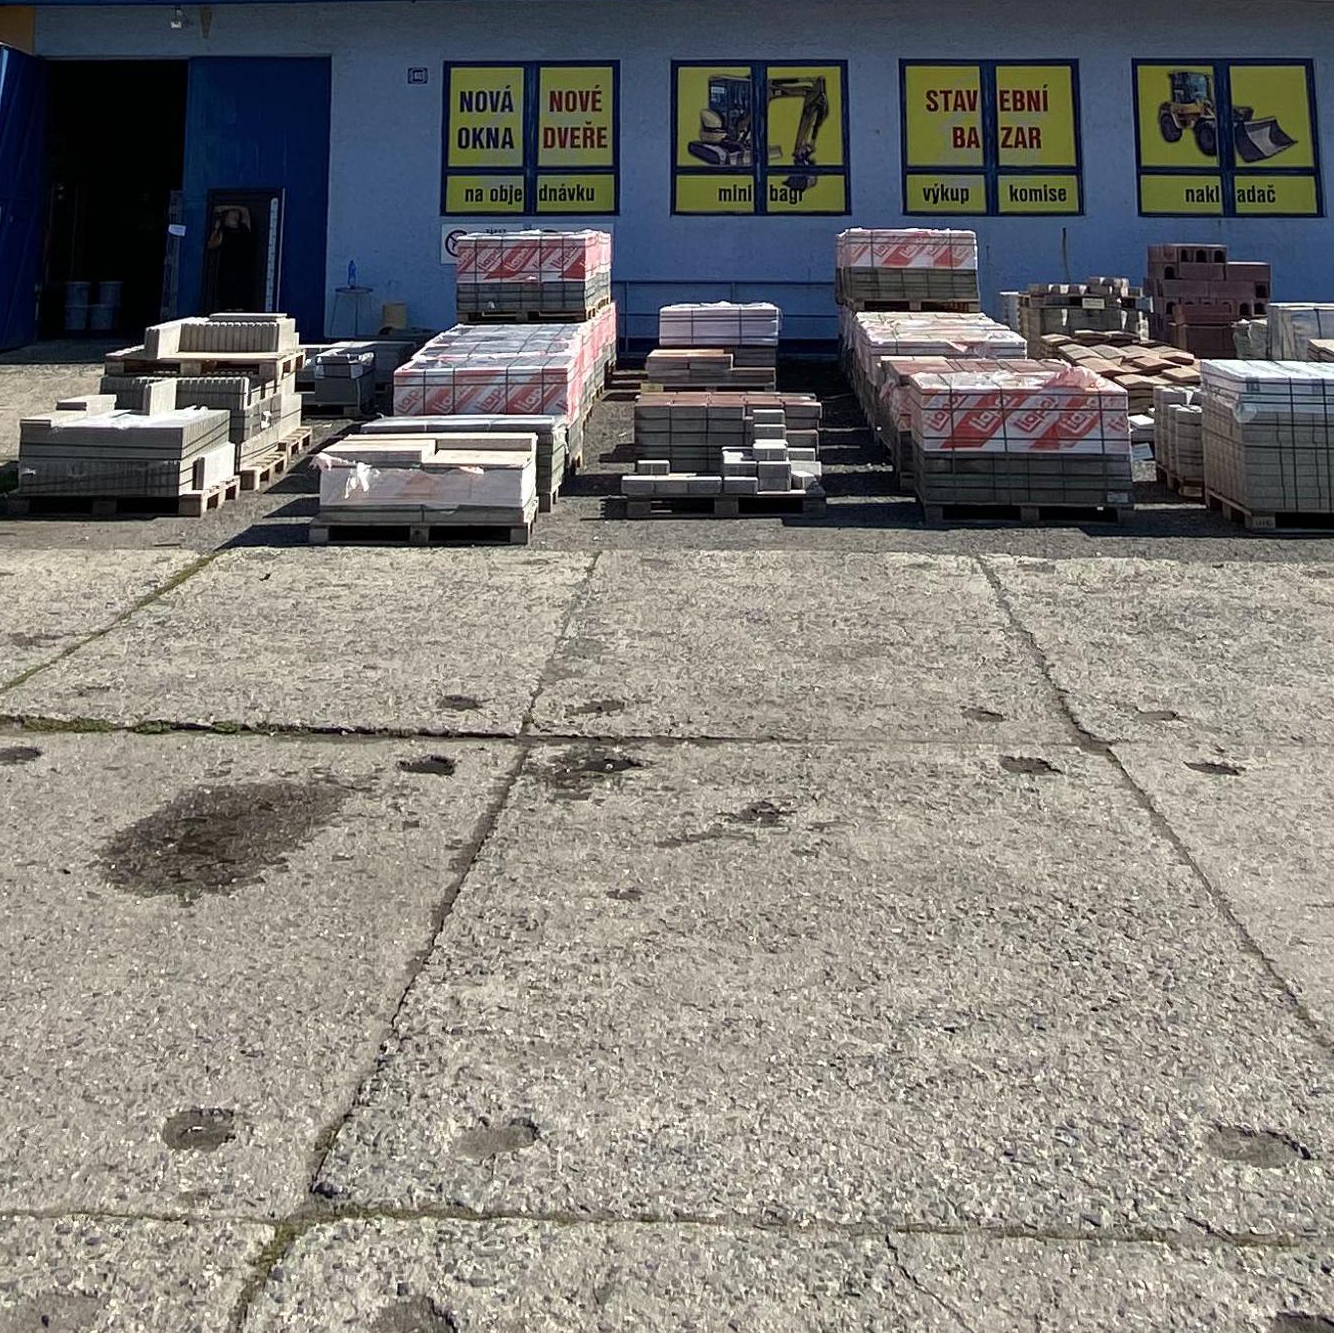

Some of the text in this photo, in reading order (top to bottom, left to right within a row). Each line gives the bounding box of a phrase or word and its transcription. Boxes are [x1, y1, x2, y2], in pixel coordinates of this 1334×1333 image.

[459, 85, 515, 114] NOVÁ
[548, 84, 603, 113] NOVÉ
[457, 127, 515, 150] OKNA
[542, 121, 608, 150] DVEŘE
[464, 188, 484, 203] na
[717, 184, 752, 203] mini
[922, 183, 1067, 206] výkup komise
